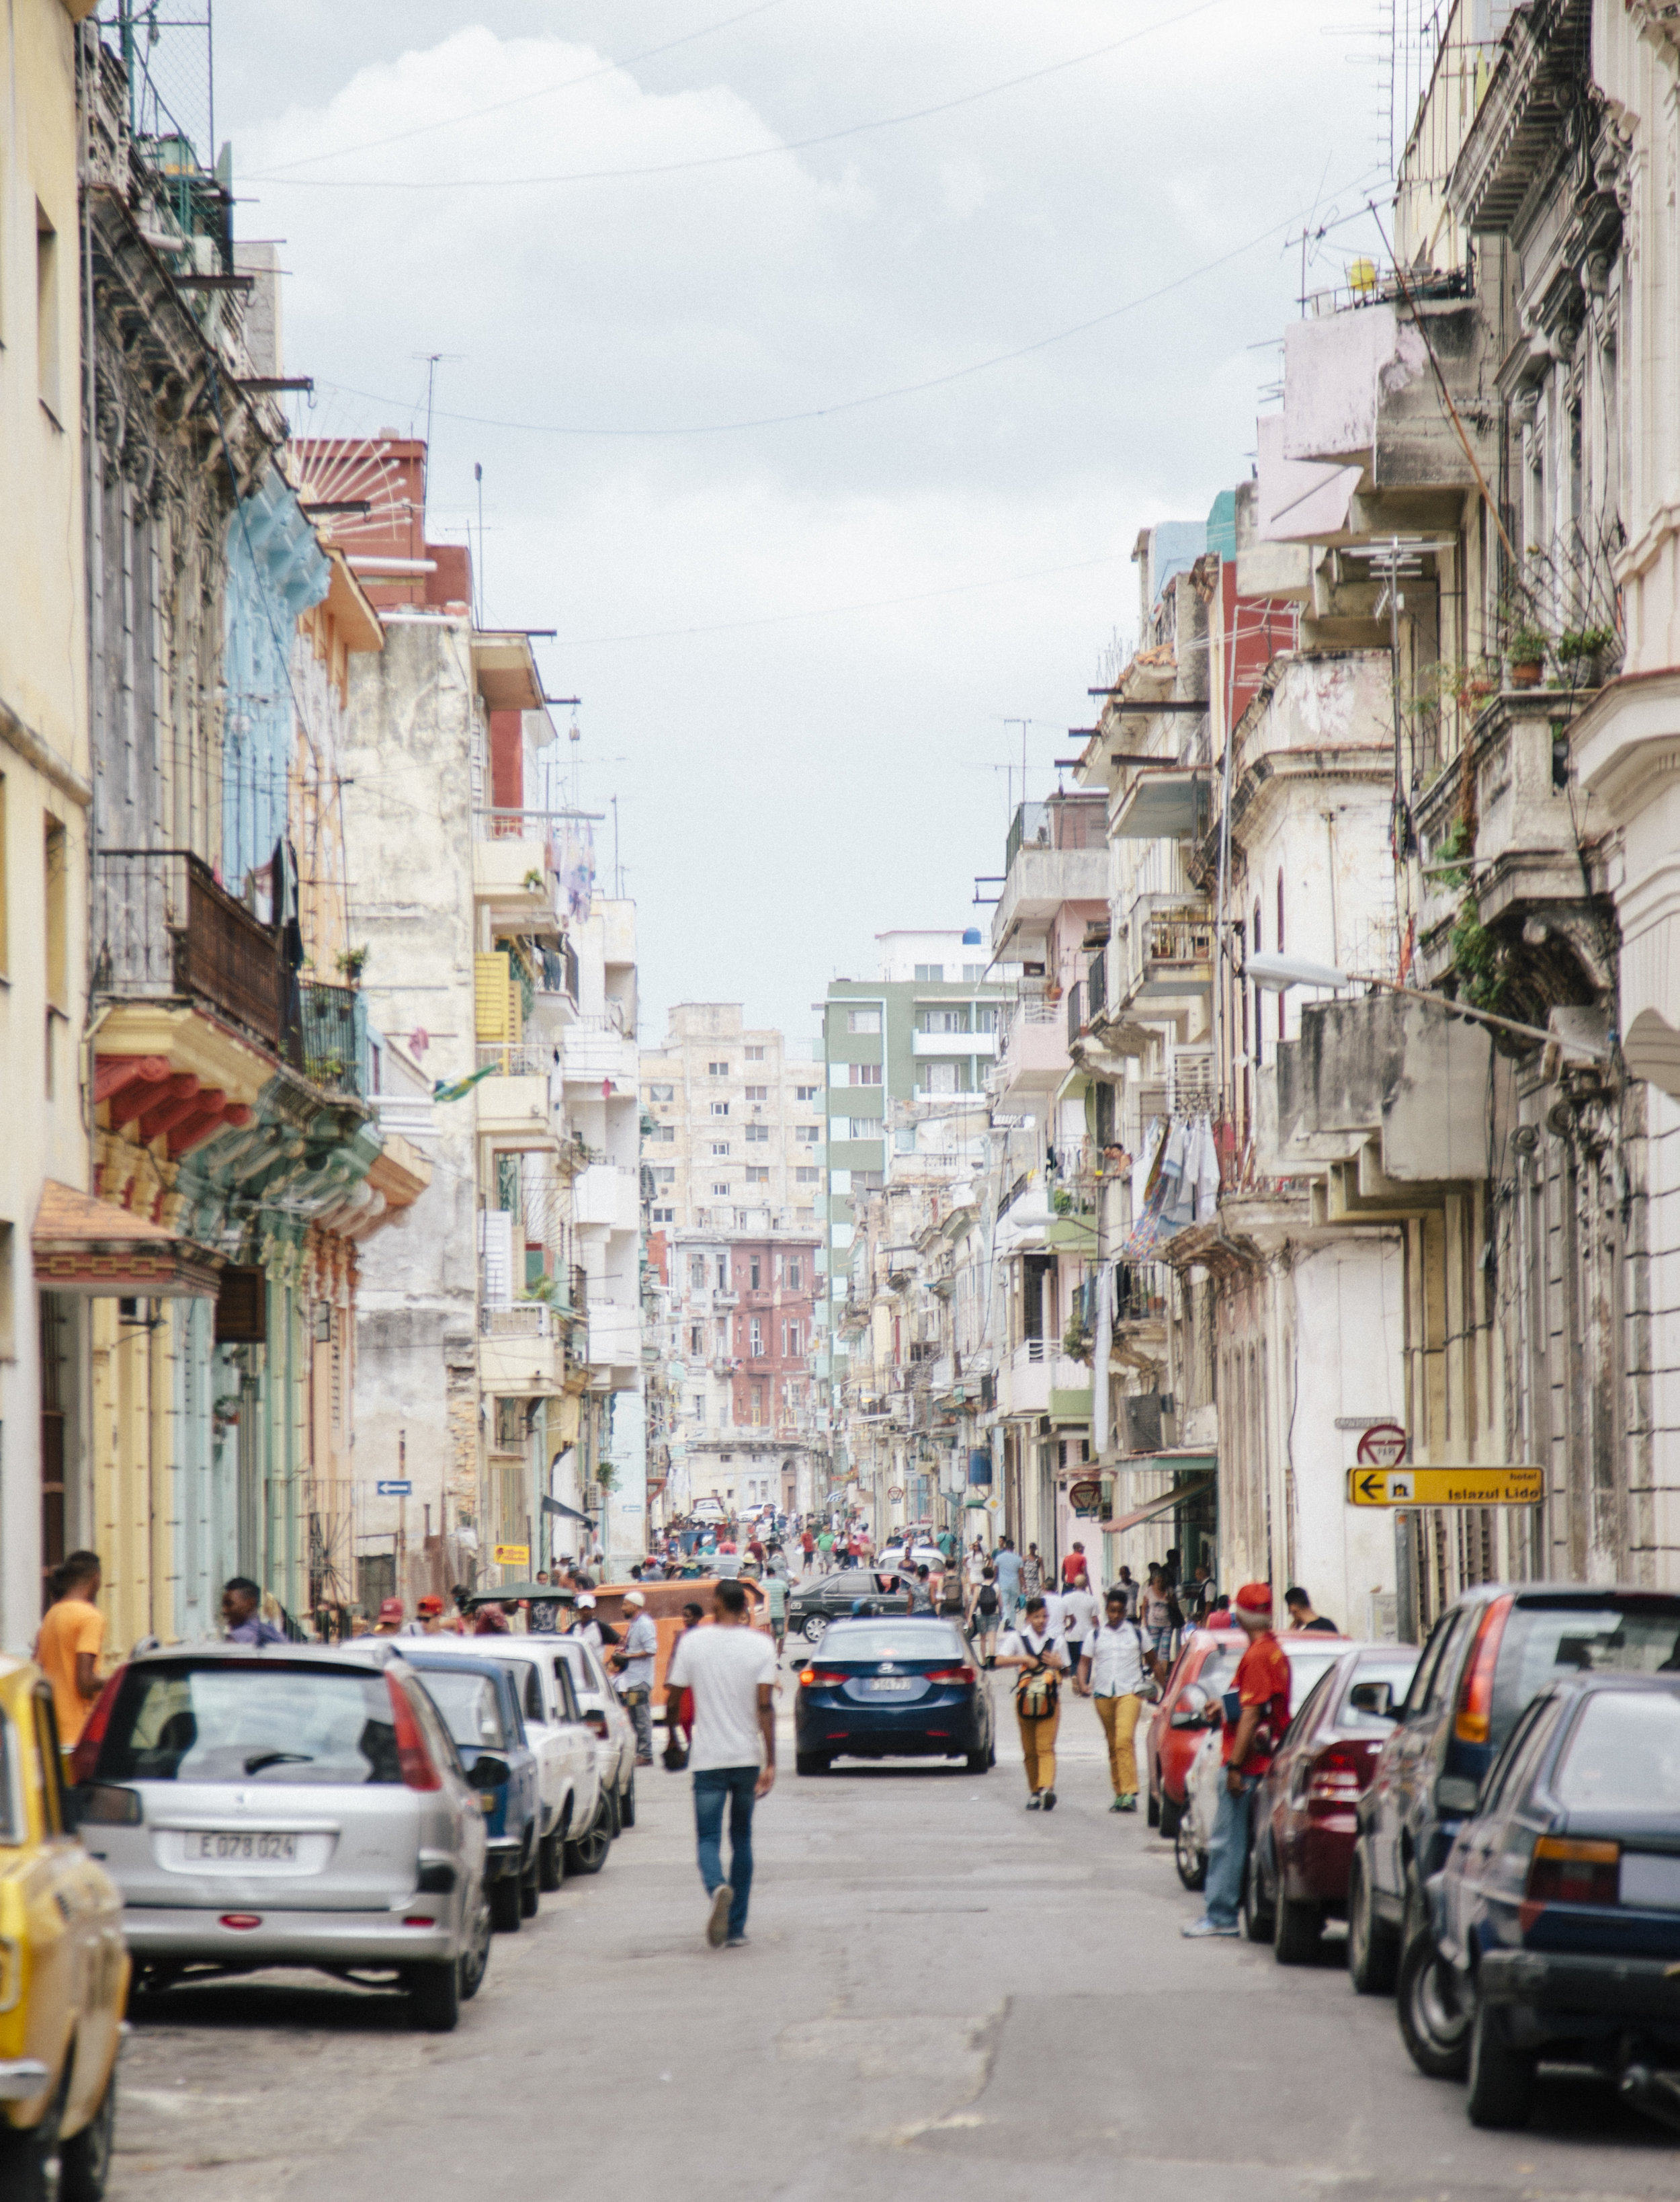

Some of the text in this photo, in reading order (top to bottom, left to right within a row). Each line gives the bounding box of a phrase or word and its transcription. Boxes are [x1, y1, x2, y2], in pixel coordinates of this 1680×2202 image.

[1449, 1487, 1539, 1500] Islazul Lido
[201, 1836, 212, 1857] E
